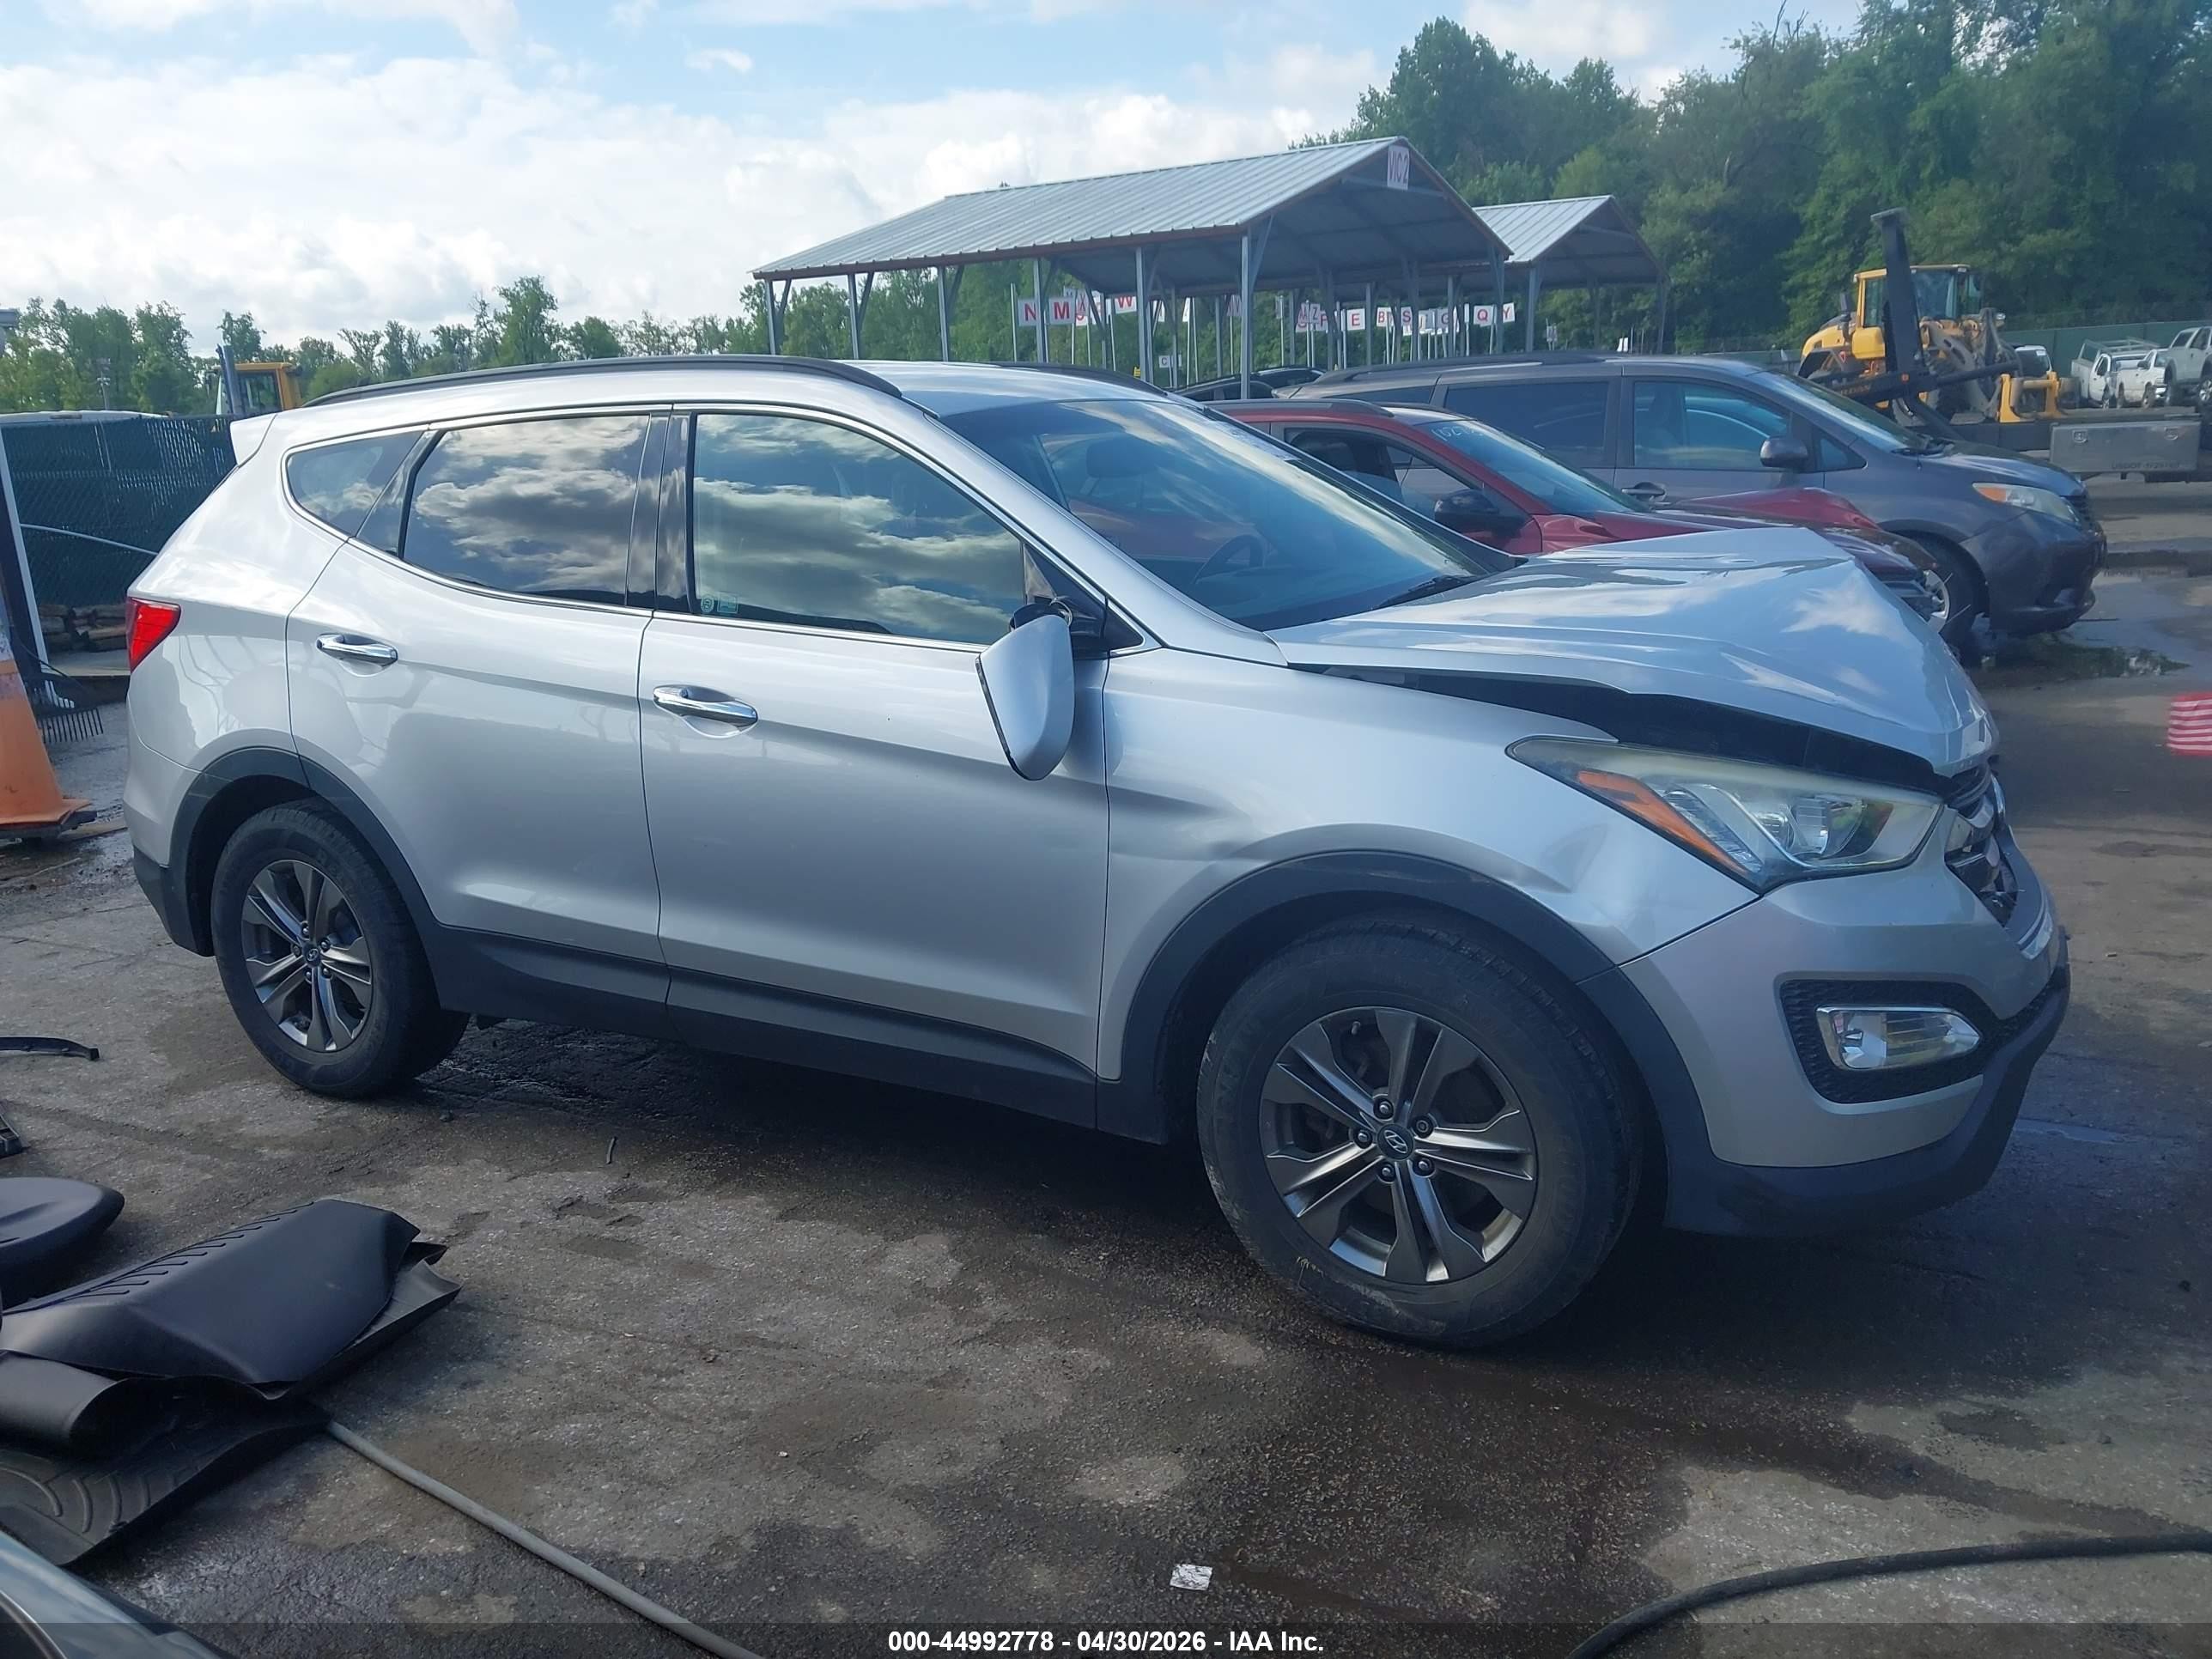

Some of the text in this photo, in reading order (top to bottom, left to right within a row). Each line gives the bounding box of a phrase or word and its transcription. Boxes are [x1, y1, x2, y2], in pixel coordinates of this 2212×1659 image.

[1116, 296, 1133, 308] W
[1024, 301, 1037, 321] N
[1054, 302, 1070, 319] M
[1378, 311, 1385, 323] B
[1402, 310, 1411, 322] S
[1478, 309, 1488, 322] Q
[1503, 306, 1510, 319] Y
[1352, 313, 1360, 326] E
